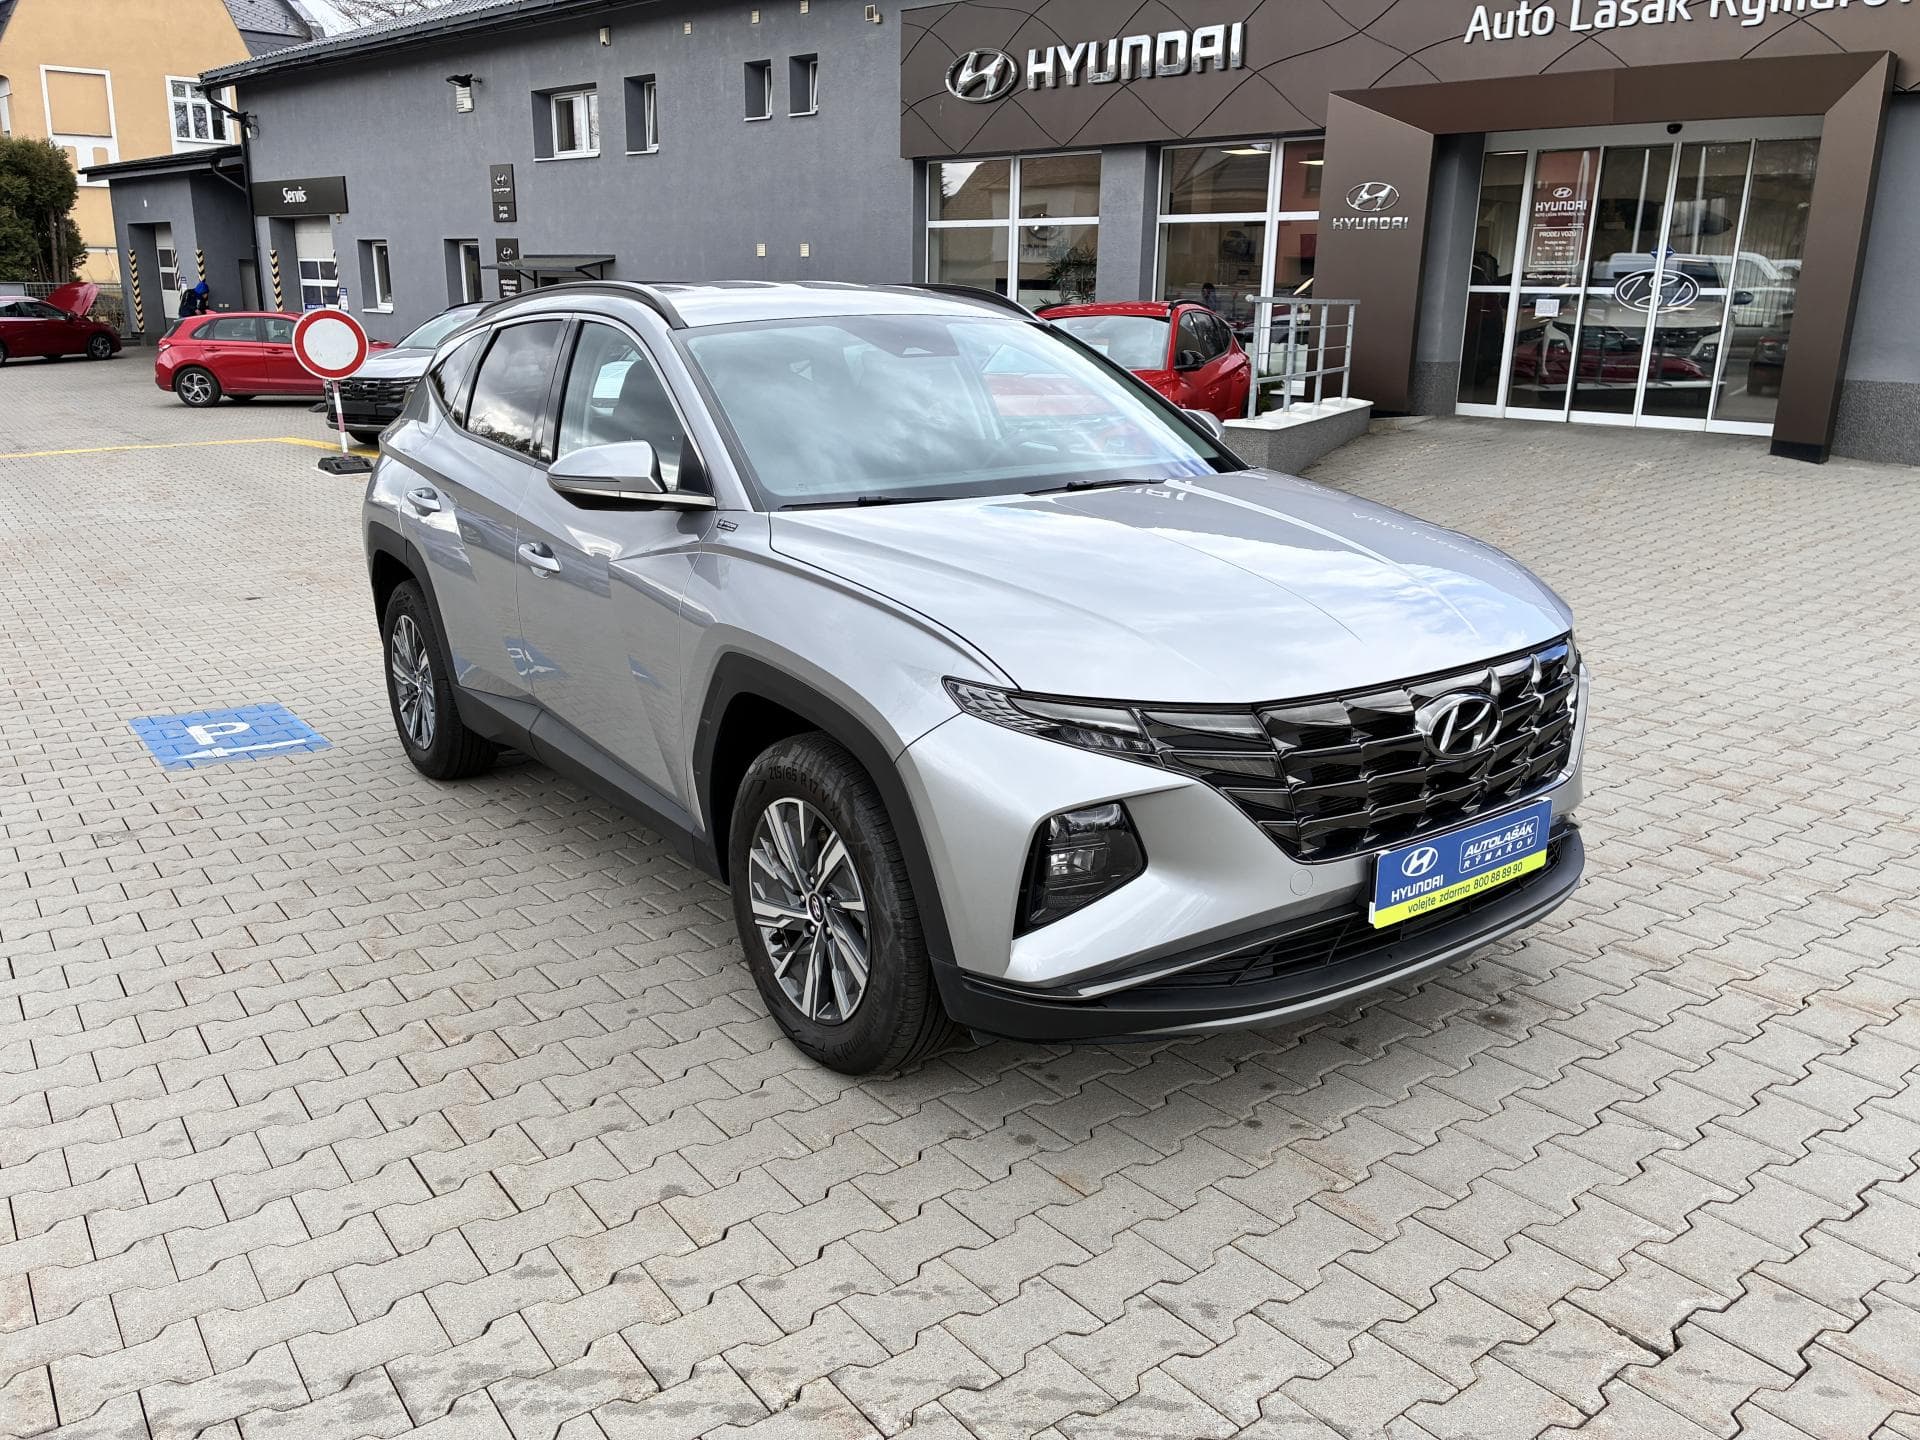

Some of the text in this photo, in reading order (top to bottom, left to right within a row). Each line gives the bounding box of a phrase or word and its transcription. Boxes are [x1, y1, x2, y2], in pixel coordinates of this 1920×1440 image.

[1463, 1, 1556, 43] Auto
[1026, 22, 1246, 90] HYUNDAI
[282, 186, 307, 203] Servis
[1535, 200, 1587, 212] HYUNDAI
[1332, 216, 1409, 230] HYUNDAI
[185, 722, 249, 745] P
[1464, 822, 1534, 858] AUTOLAŠÁK
[1391, 874, 1444, 903] HYUNDAI
[1408, 862, 1523, 913] volejte zdarma 800 88 89 90
